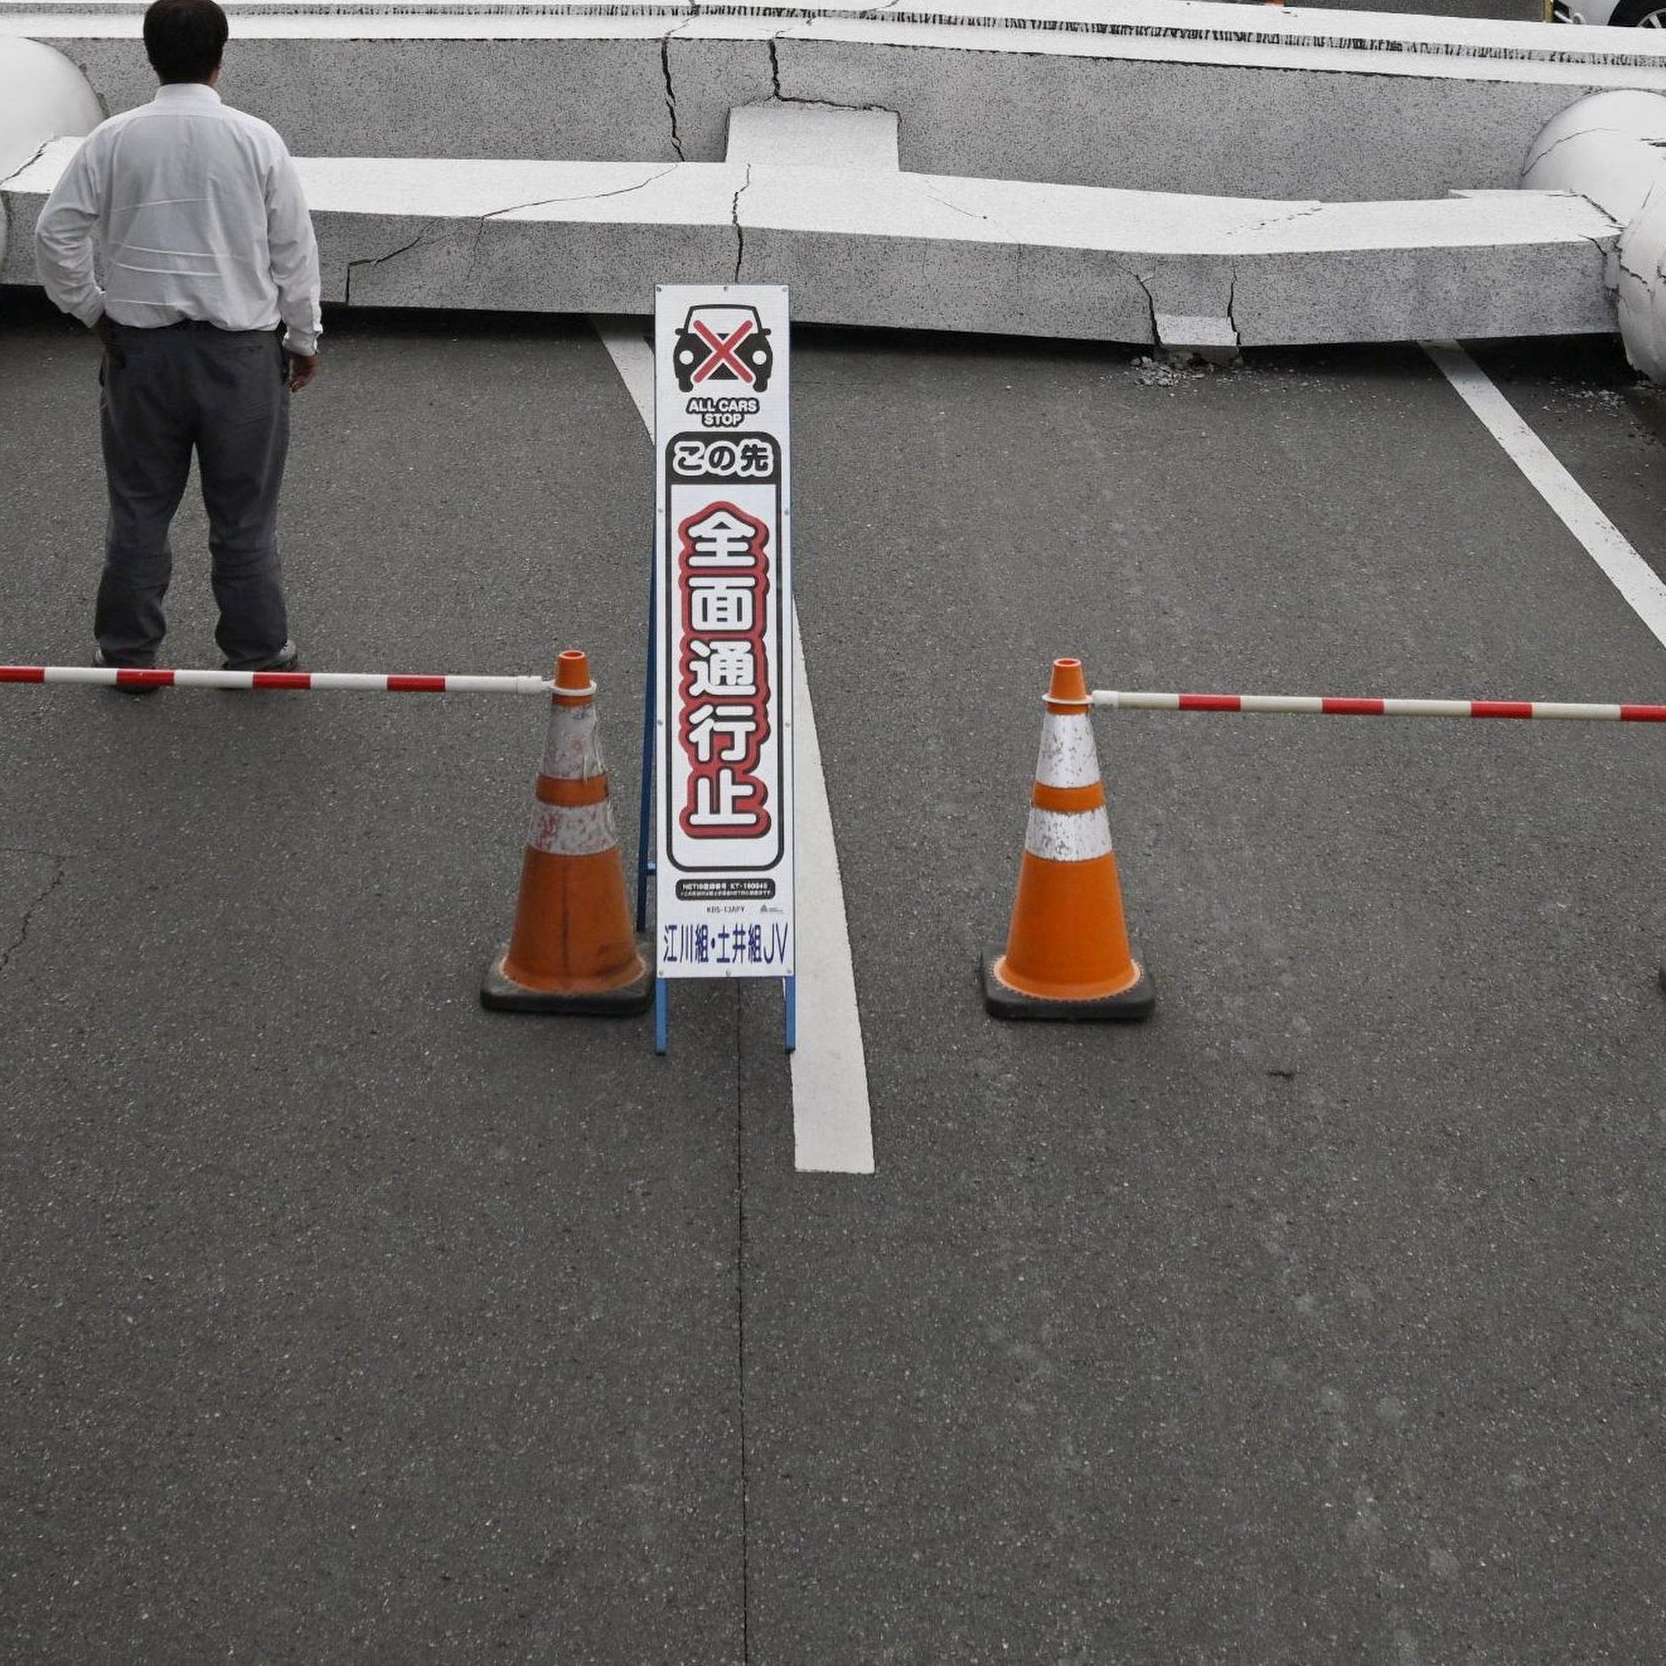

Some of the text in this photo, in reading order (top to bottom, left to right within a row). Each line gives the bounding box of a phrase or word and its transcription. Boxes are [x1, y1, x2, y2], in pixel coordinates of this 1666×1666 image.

[687, 399, 758, 413] ALL CARS
[703, 413, 743, 425] STOP
[675, 441, 771, 474] この先
[686, 508, 760, 828] 全面通行止
[663, 922, 789, 964] 江川組・土井組JV
